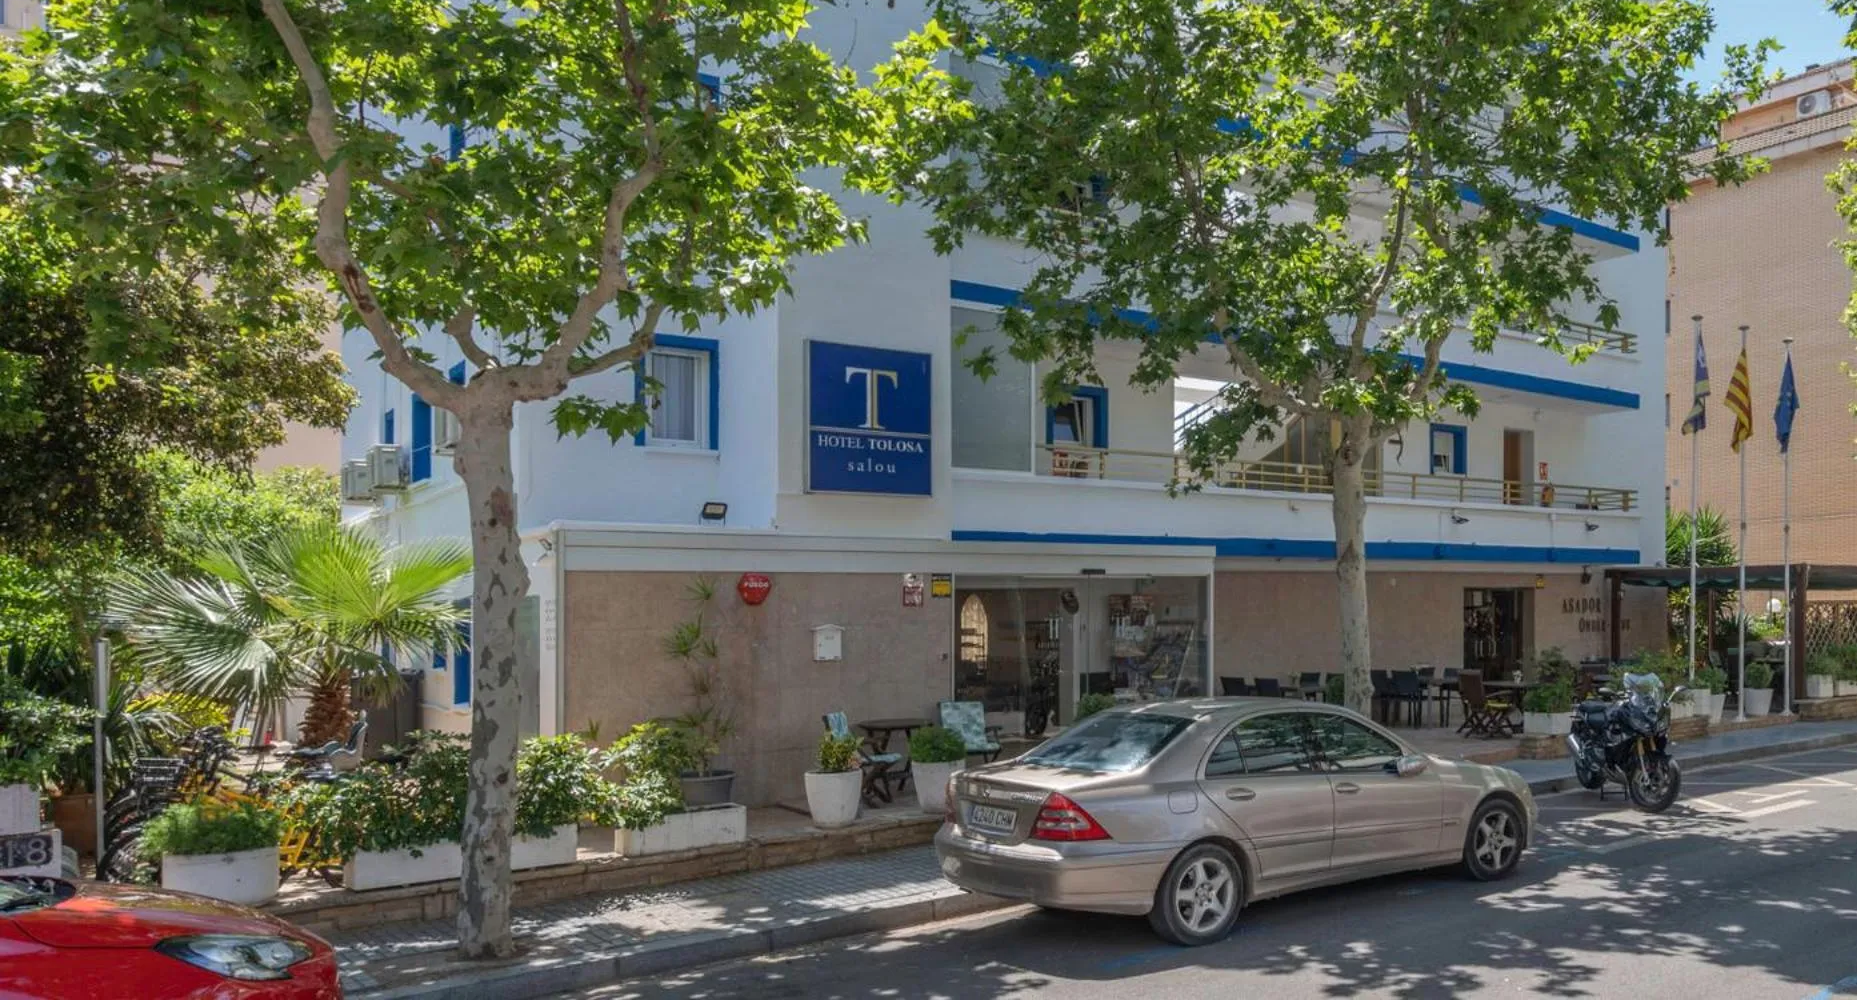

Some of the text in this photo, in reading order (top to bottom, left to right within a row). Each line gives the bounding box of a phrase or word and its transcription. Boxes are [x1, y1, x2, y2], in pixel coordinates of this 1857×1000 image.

[845, 366, 898, 430] T
[818, 434, 924, 453] HOTEL TOLOSA
[847, 458, 896, 473] salou
[1561, 598, 1601, 613] ASADOR
